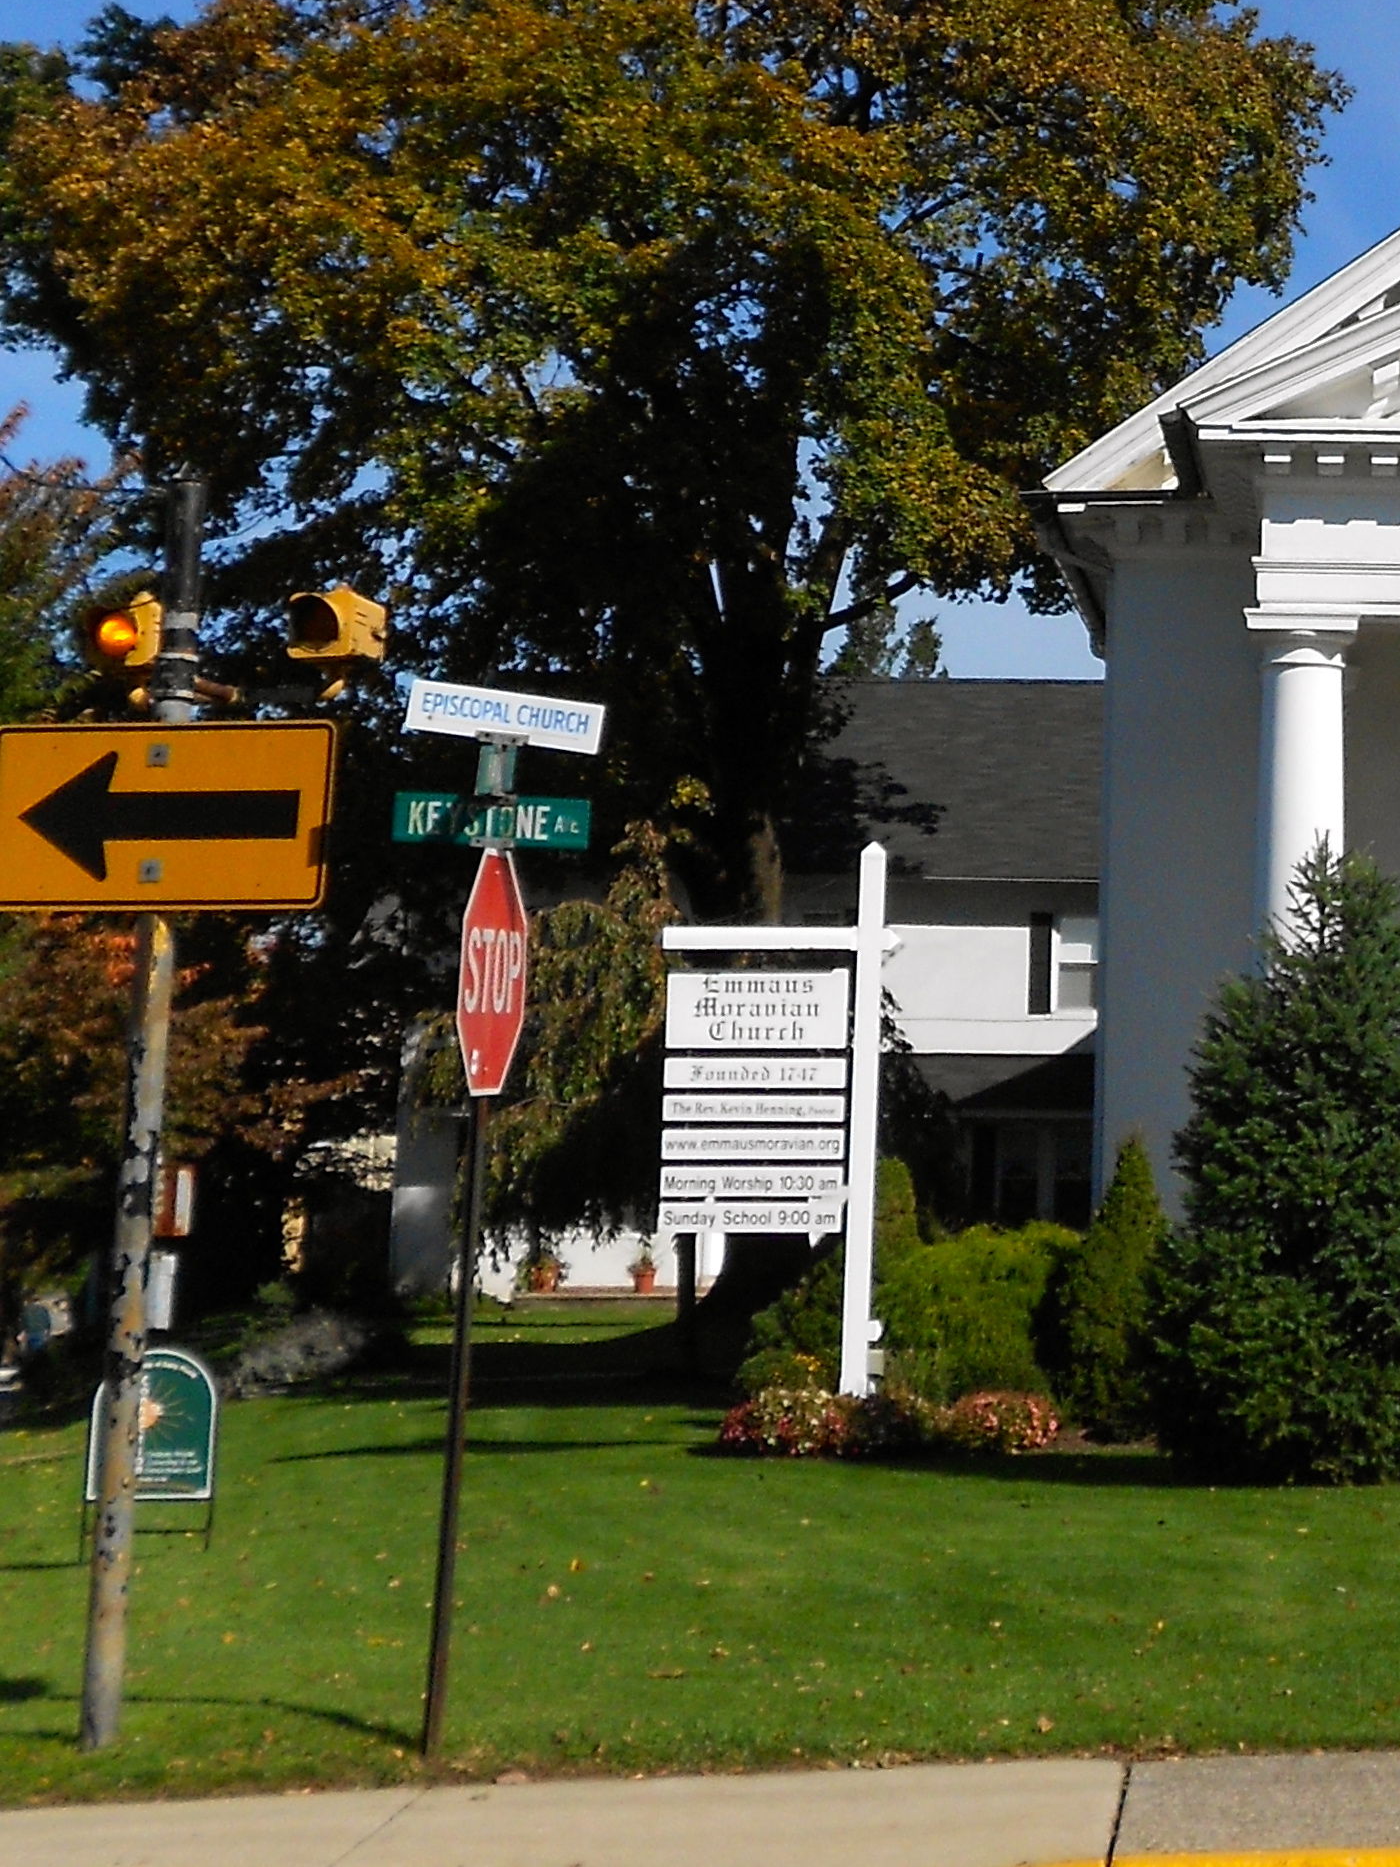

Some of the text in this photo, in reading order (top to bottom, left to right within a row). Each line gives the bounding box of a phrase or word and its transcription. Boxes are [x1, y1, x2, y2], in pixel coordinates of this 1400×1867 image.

[421, 691, 590, 734] EPISCOPAL CHURCH
[407, 800, 551, 840] KEYSTONE
[464, 926, 521, 1014] STOP
[702, 975, 814, 994] Emmaus
[693, 996, 820, 1018] Moravian
[708, 1020, 804, 1042] Church
[689, 1065, 819, 1082] Founded 1747
[672, 1101, 691, 1114] The
[695, 1102, 716, 1115] Rev.
[720, 1102, 751, 1115] Kevin
[665, 1137, 840, 1153] www.emmausmoravian.org
[664, 1175, 838, 1193] Morning Worship 10:30 am
[663, 1209, 837, 1228] Sunday School 9:00 am
